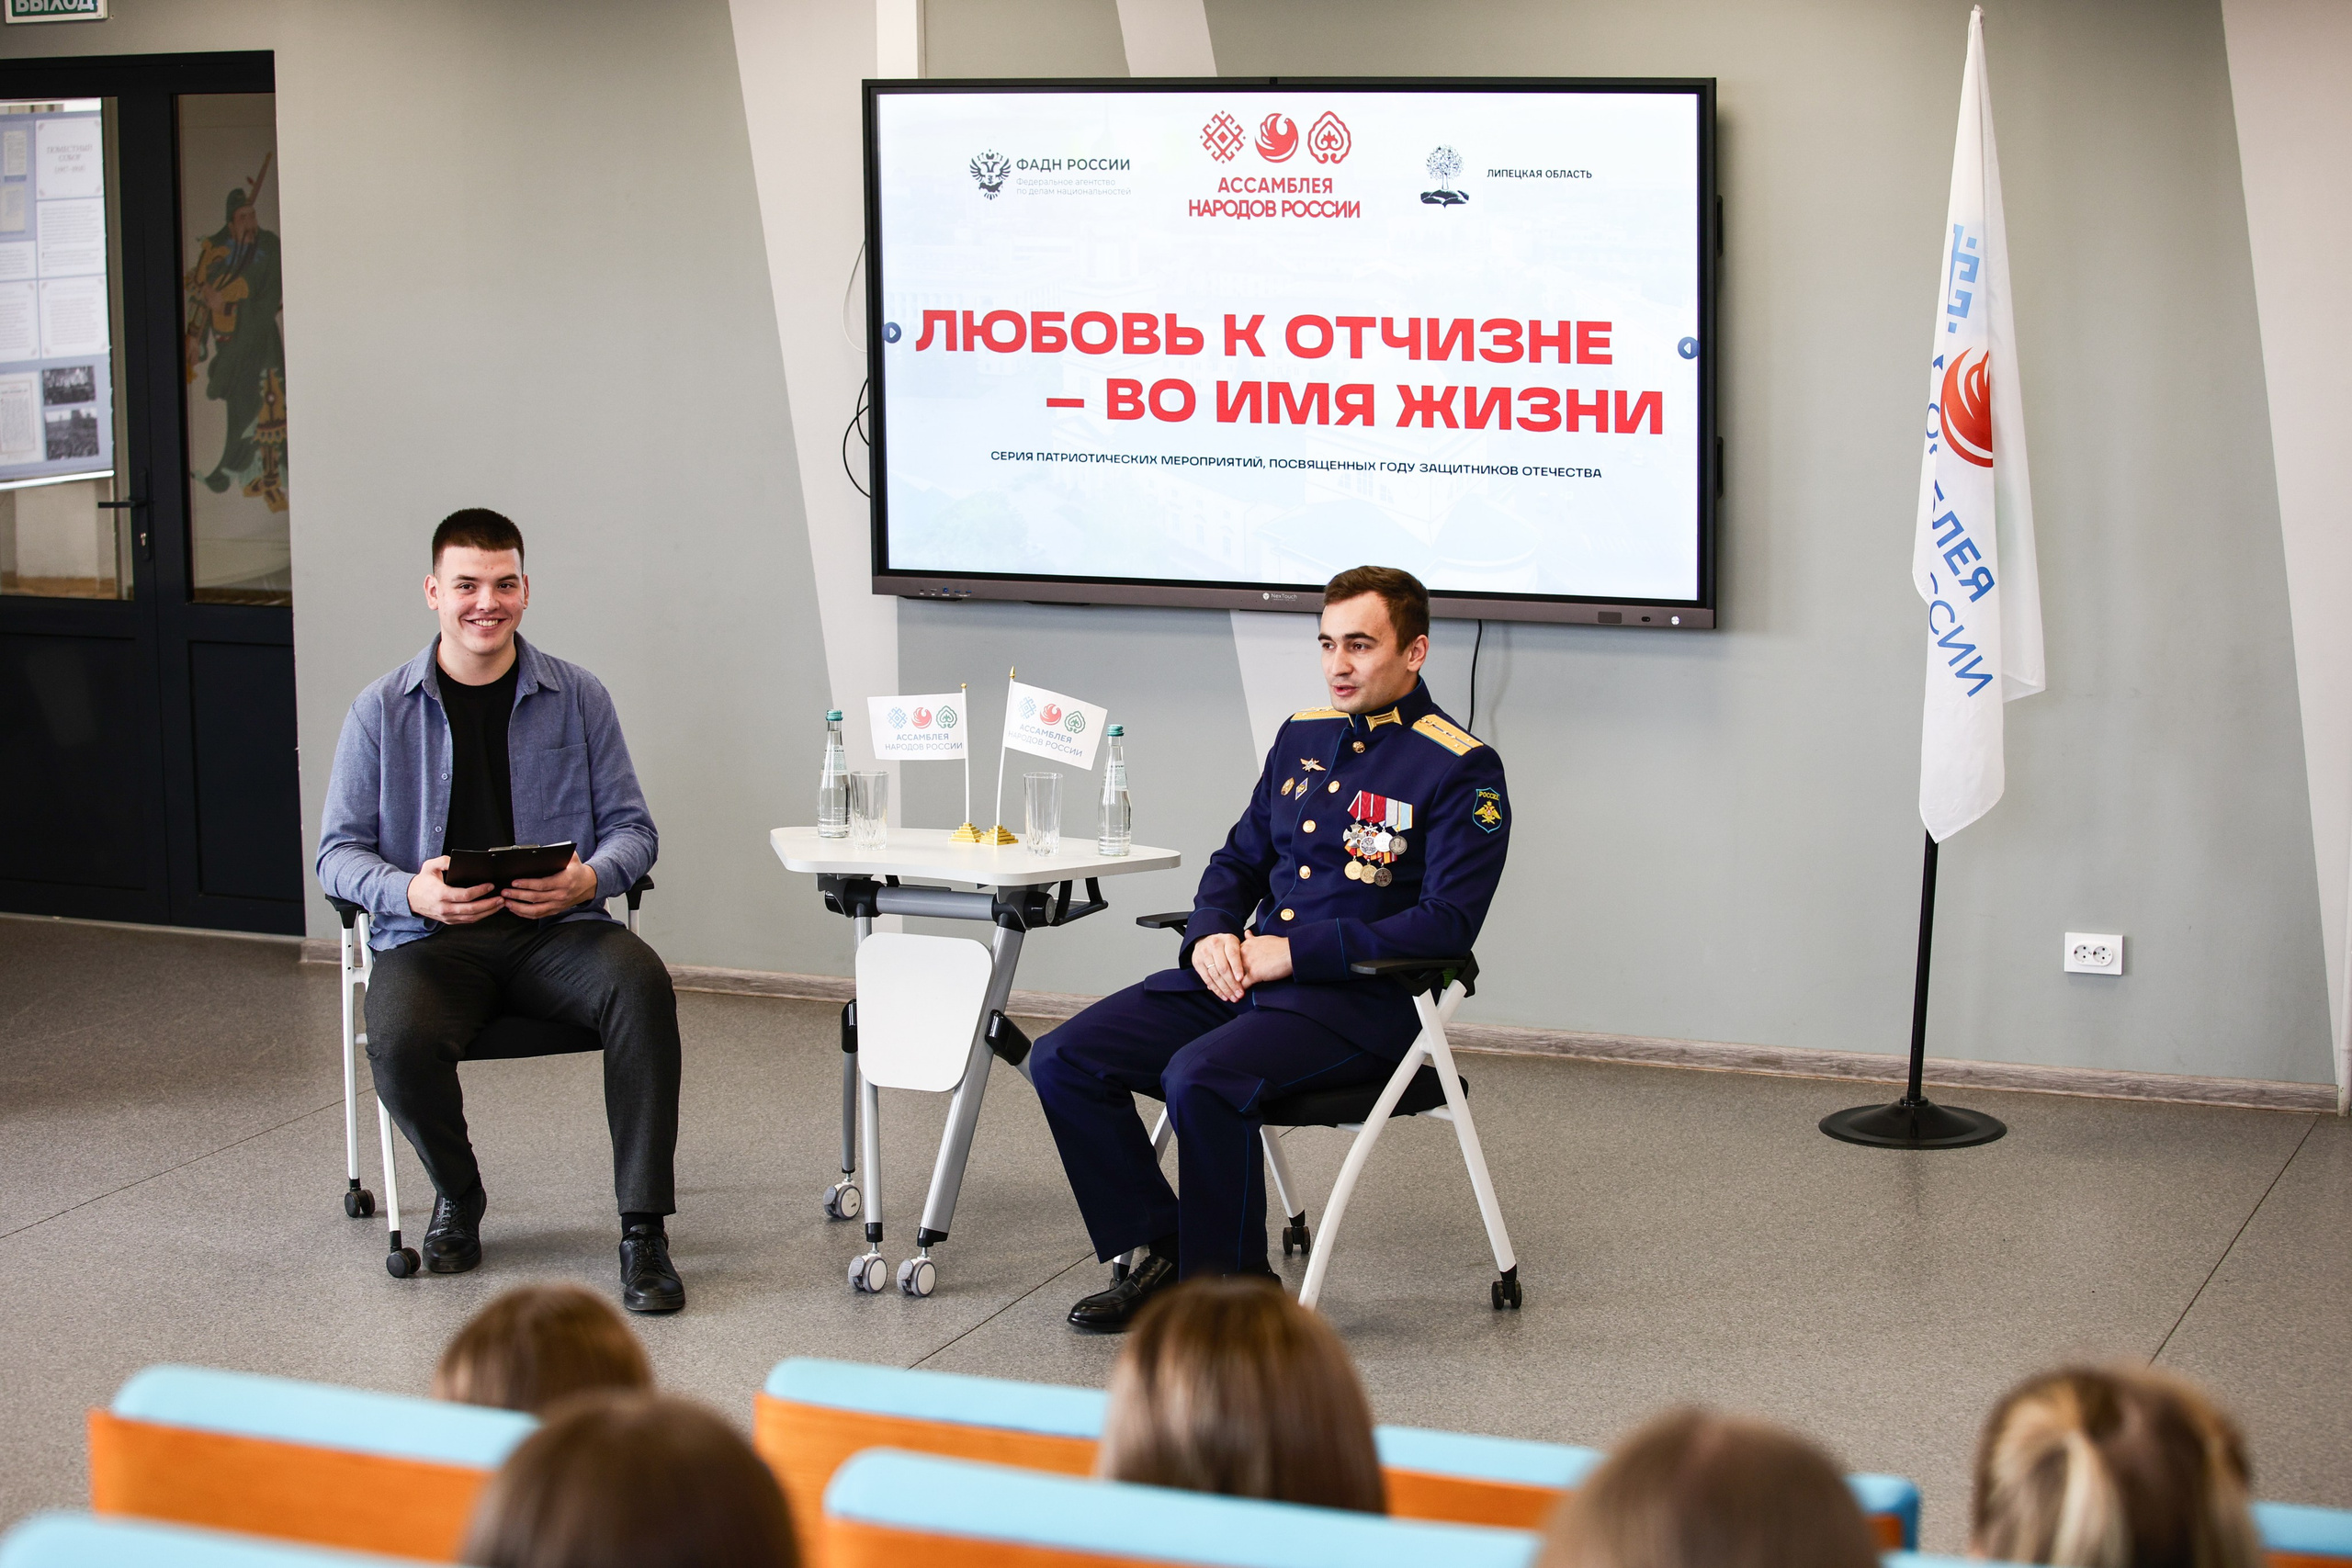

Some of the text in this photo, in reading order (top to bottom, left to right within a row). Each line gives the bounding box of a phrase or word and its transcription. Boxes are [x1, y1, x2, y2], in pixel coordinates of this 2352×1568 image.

[1016, 158, 1131, 173] ФАДН РОССИИ
[1487, 169, 1593, 179] ЛИПЕЦКАЯ ОБЛАСТЬ
[1016, 177, 1073, 186] Федеральное
[1217, 176, 1333, 194] АССАМБЛЕЯ
[1057, 186, 1132, 197] национальностей
[1189, 198, 1361, 220] НАРОДОВ РОССИИ
[915, 309, 1613, 365] ЛЮБОВЬ К ОТЧИЗНЕ
[1106, 378, 1196, 423] ВО
[1216, 379, 1375, 426] ИМЯ
[1396, 383, 1663, 434] ЖИЗНИ
[990, 450, 1602, 479] СЕРИЯ ПАТРИОТИЧЕСКИХ МЕРОПРИЯТИЙ, ПОСВЯЩЕННЫХ ГОДУ ЗАЩИТНИКОВ ОТЕЧЕСТВА
[897, 733, 949, 741] АССАМБЛЕЯ
[1020, 723, 1073, 744] АССАМБЛЕЯ
[885, 742, 963, 751] НАРОДОВ РОССИИ
[1008, 730, 1083, 757] НАРОДОВ РОССИИ
